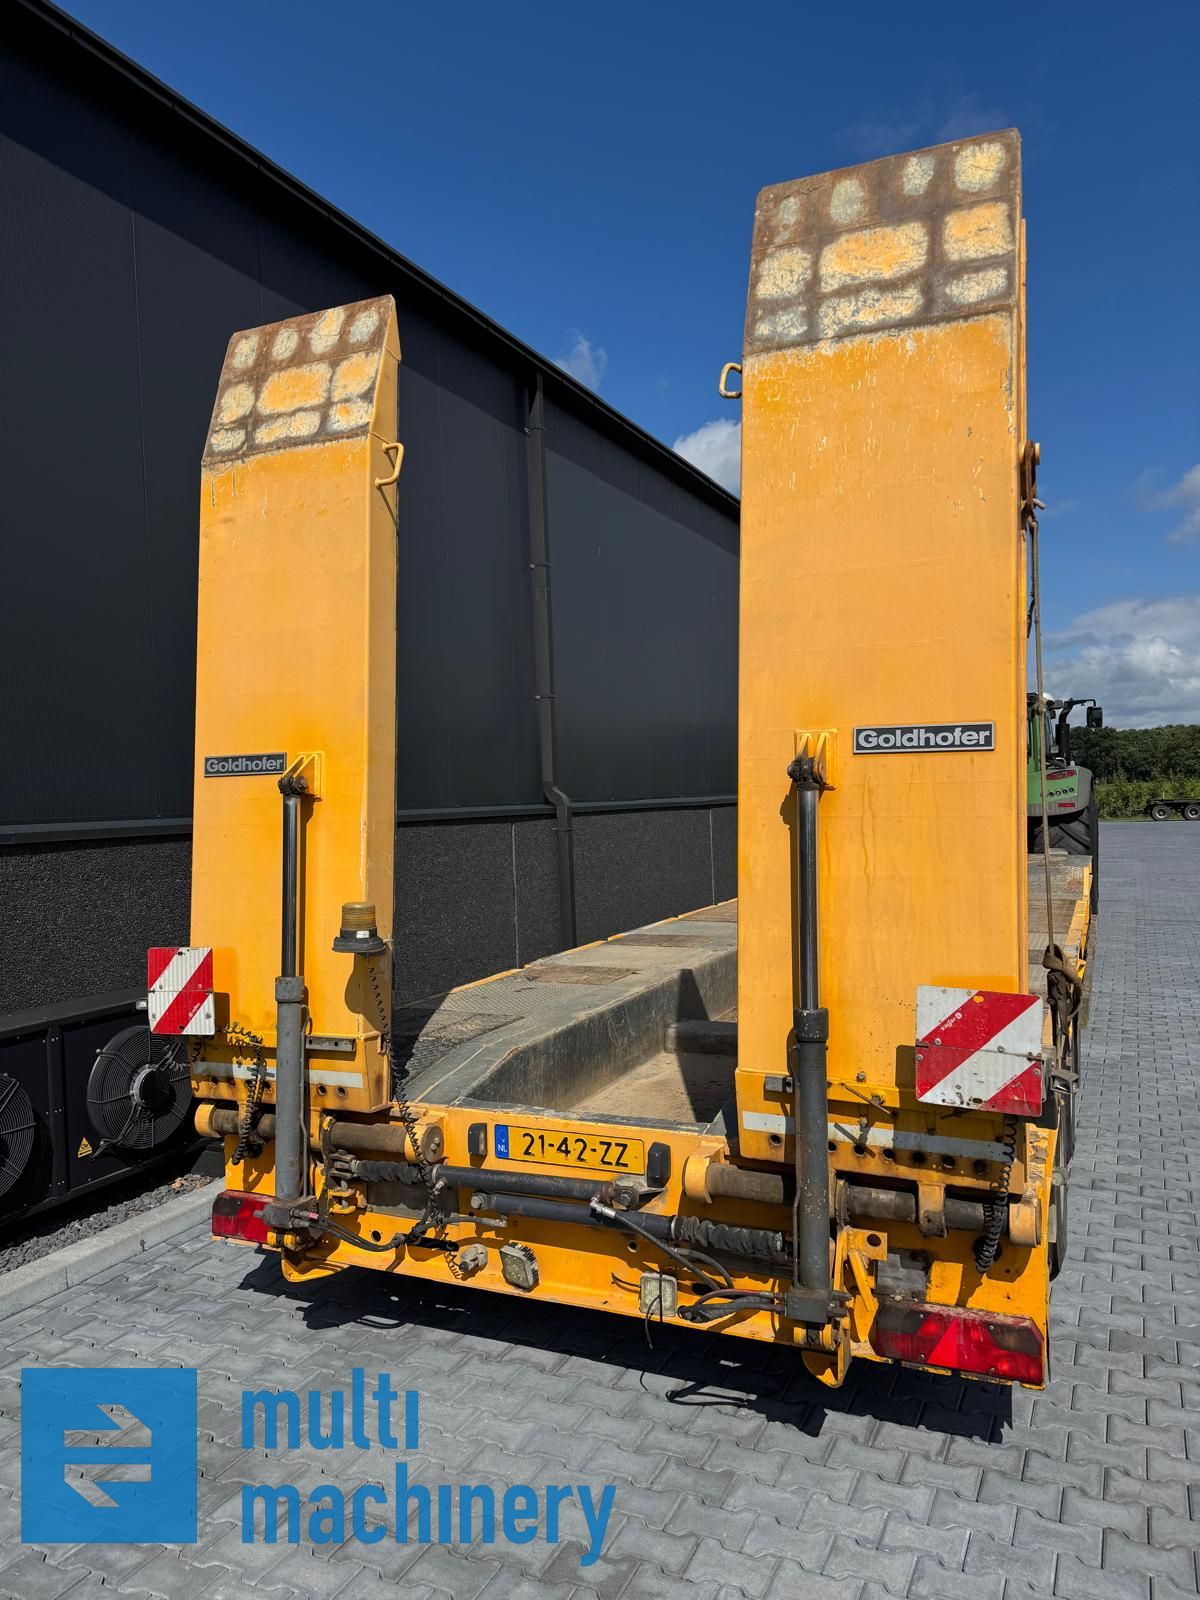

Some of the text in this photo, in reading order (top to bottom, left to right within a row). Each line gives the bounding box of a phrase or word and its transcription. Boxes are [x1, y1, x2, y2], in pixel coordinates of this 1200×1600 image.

[858, 727, 990, 748] Goldhofer
[206, 757, 283, 772] Goldhofer
[497, 1143, 508, 1153] NL
[522, 1133, 628, 1167] 21-42-ZZ
